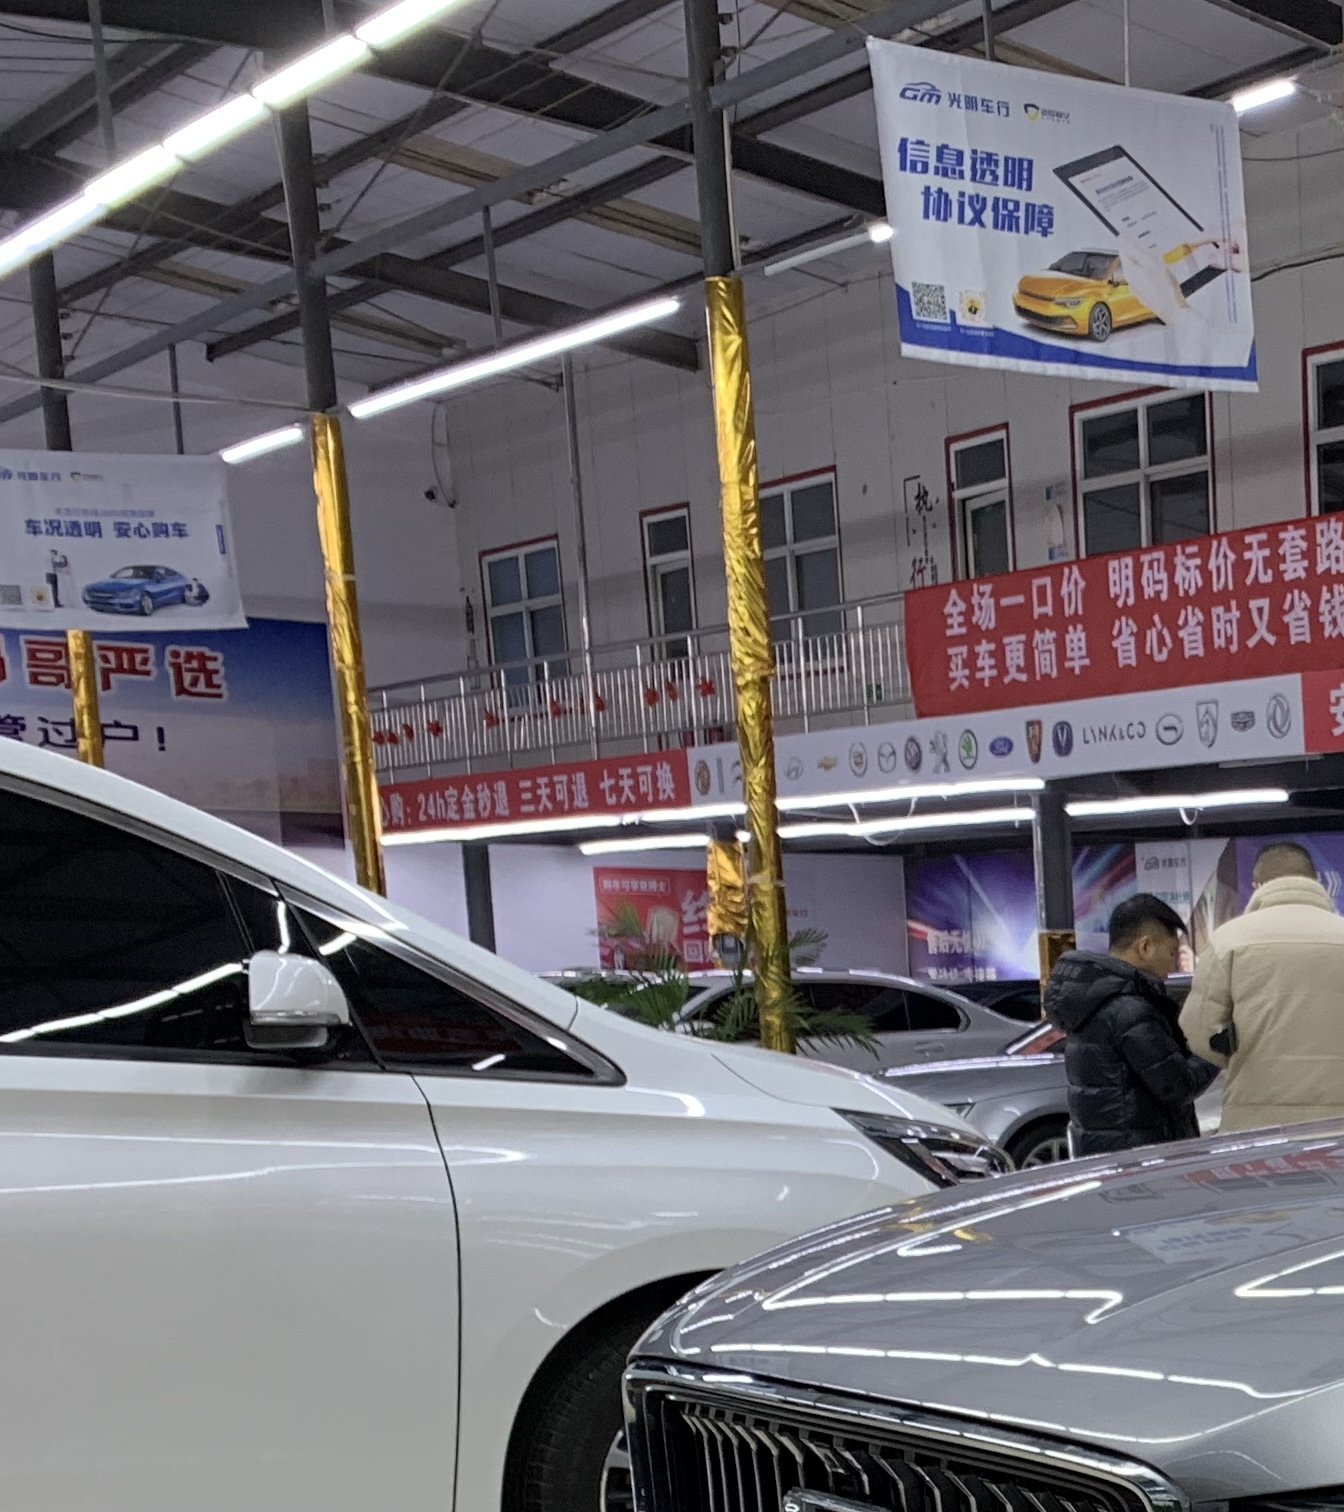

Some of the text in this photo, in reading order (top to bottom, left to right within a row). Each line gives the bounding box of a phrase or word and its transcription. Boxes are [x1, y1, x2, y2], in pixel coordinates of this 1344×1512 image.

[947, 91, 1011, 118] 光明车行
[897, 137, 1035, 191] 信息透明
[921, 185, 1055, 238] 协议保障
[25, 519, 189, 538] 车况透明 安心购车
[943, 562, 1087, 637] 全场一口价
[0, 636, 224, 699] 哥严选
[947, 624, 1090, 691] 买车更简单
[518, 771, 590, 814] 三天可退
[600, 760, 676, 806] 七天可换
